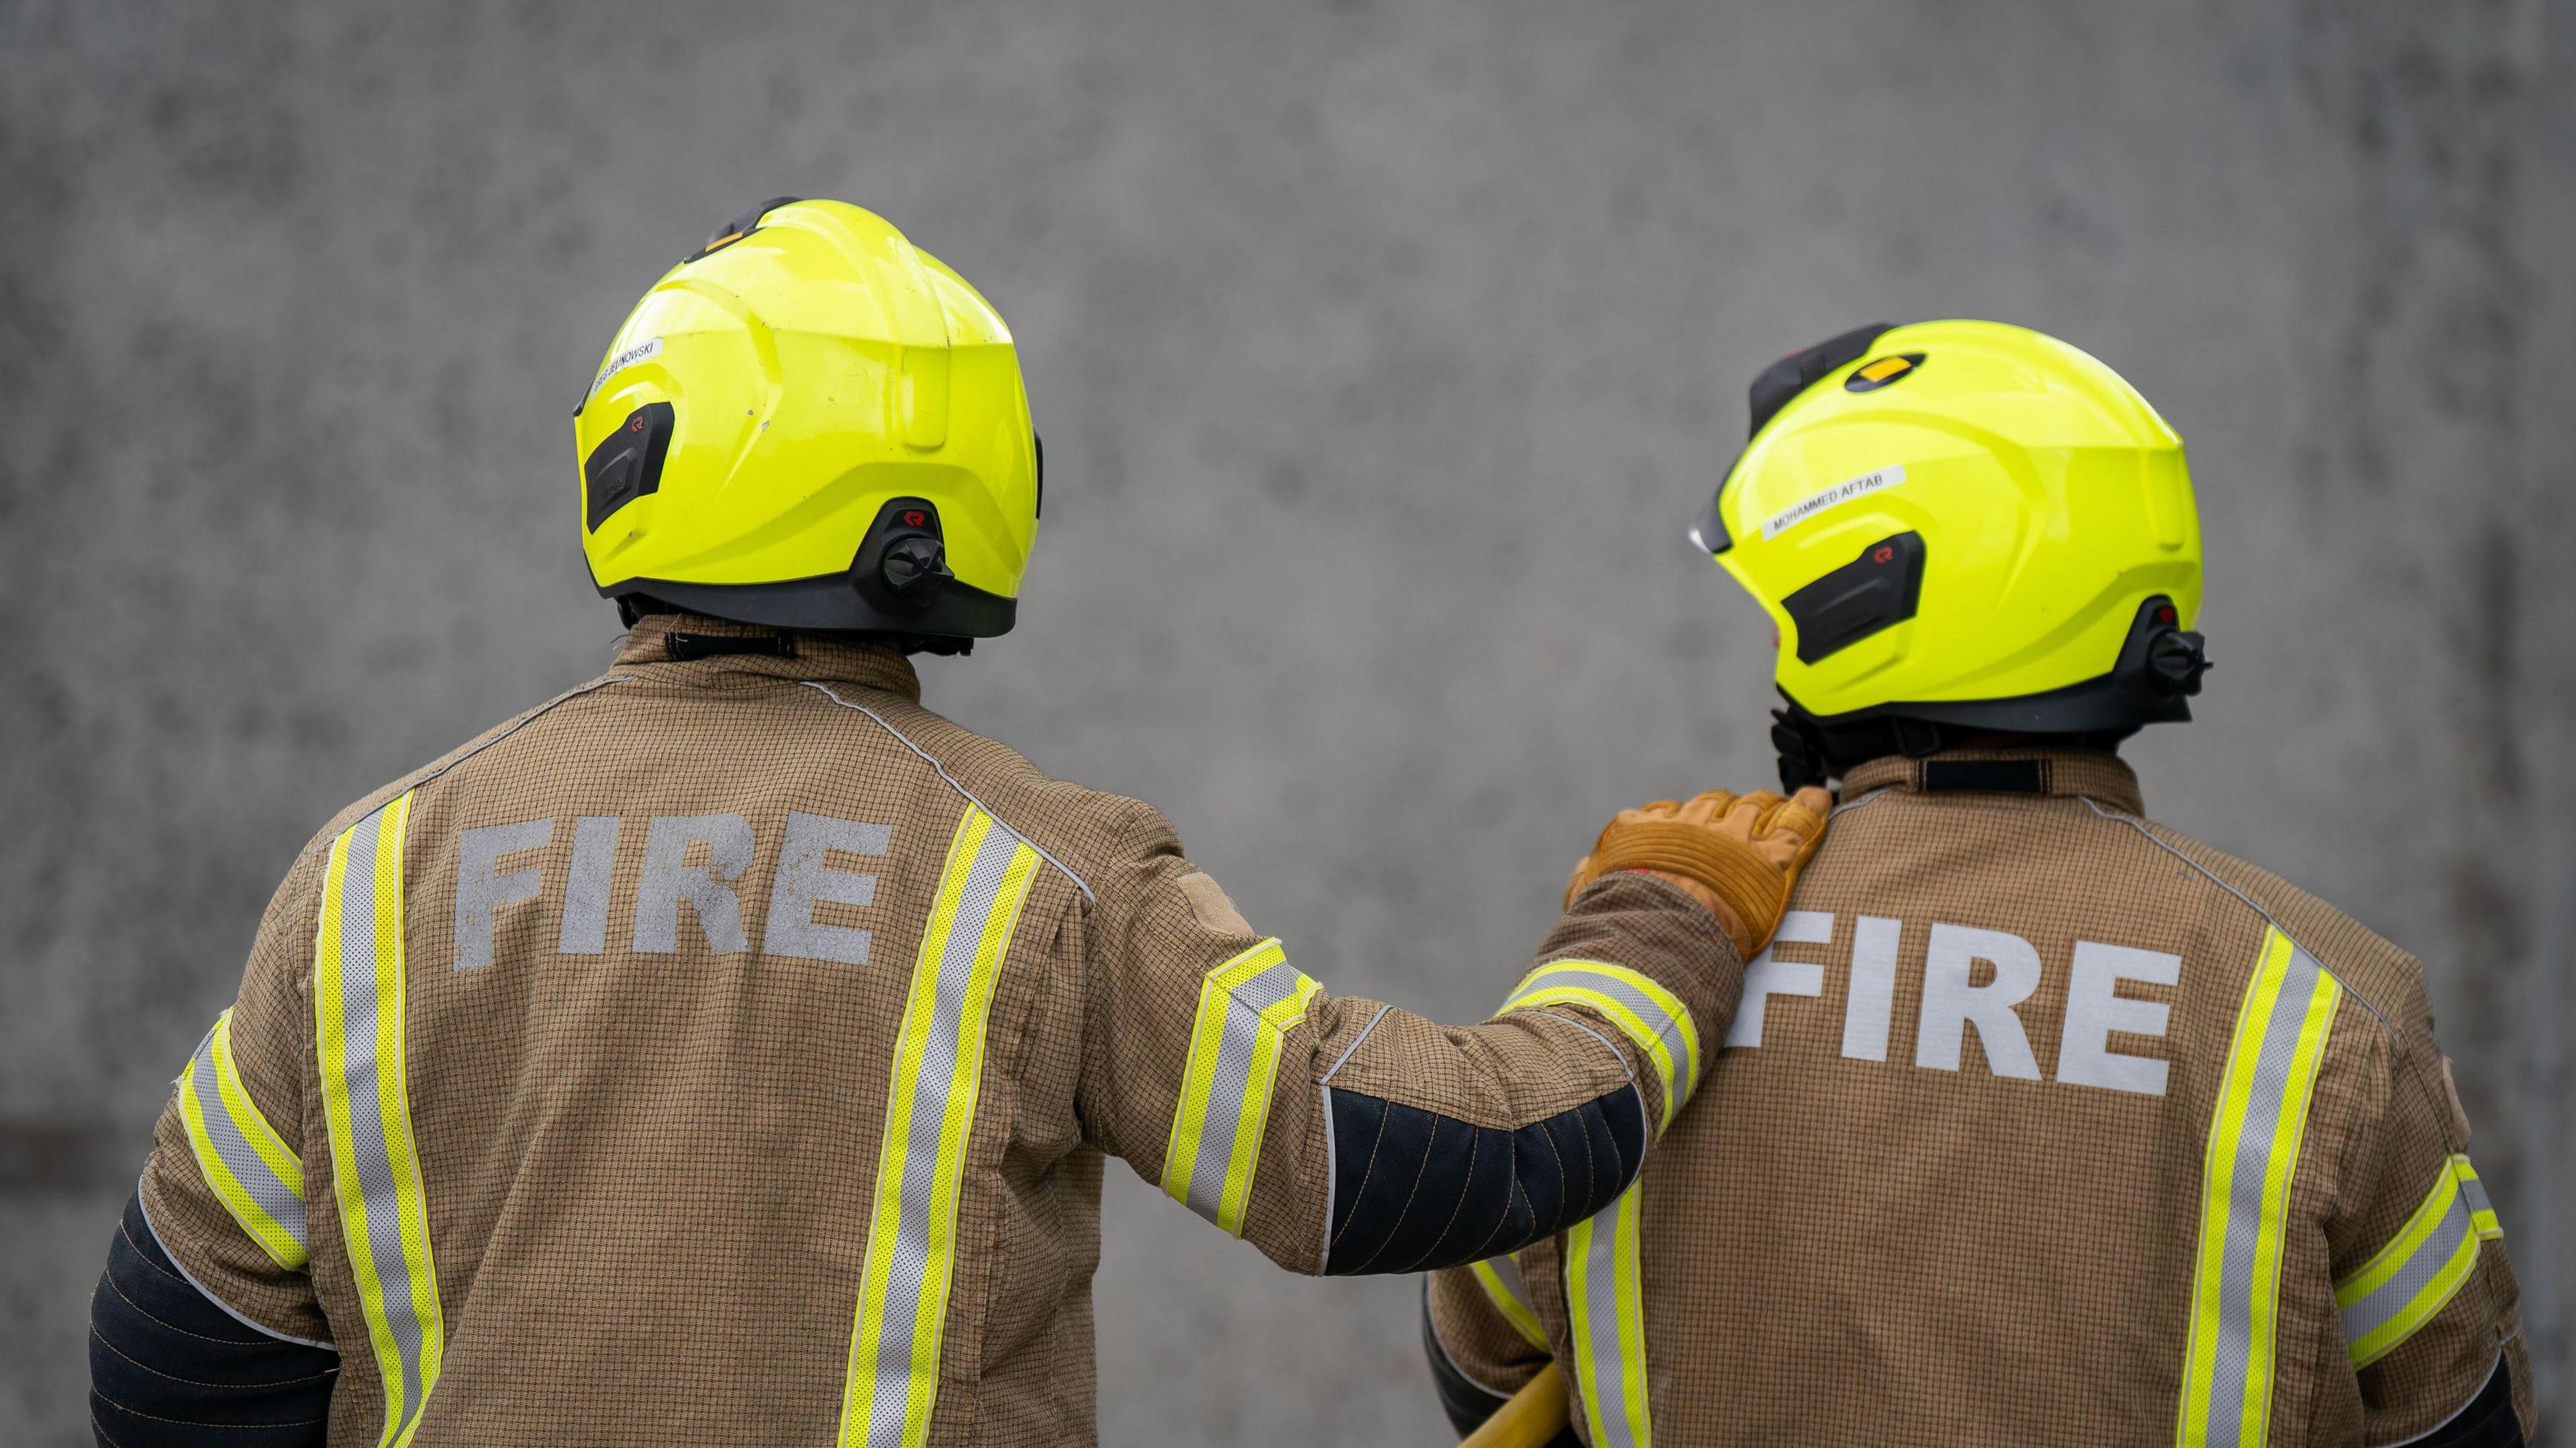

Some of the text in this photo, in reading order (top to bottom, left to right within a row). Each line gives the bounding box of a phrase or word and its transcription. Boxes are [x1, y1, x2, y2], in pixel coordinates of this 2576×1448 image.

[1773, 474, 1884, 531] MOHAMMED AFTAB
[453, 811, 894, 972] FIRE
[1722, 910, 2183, 1097] FIRE
